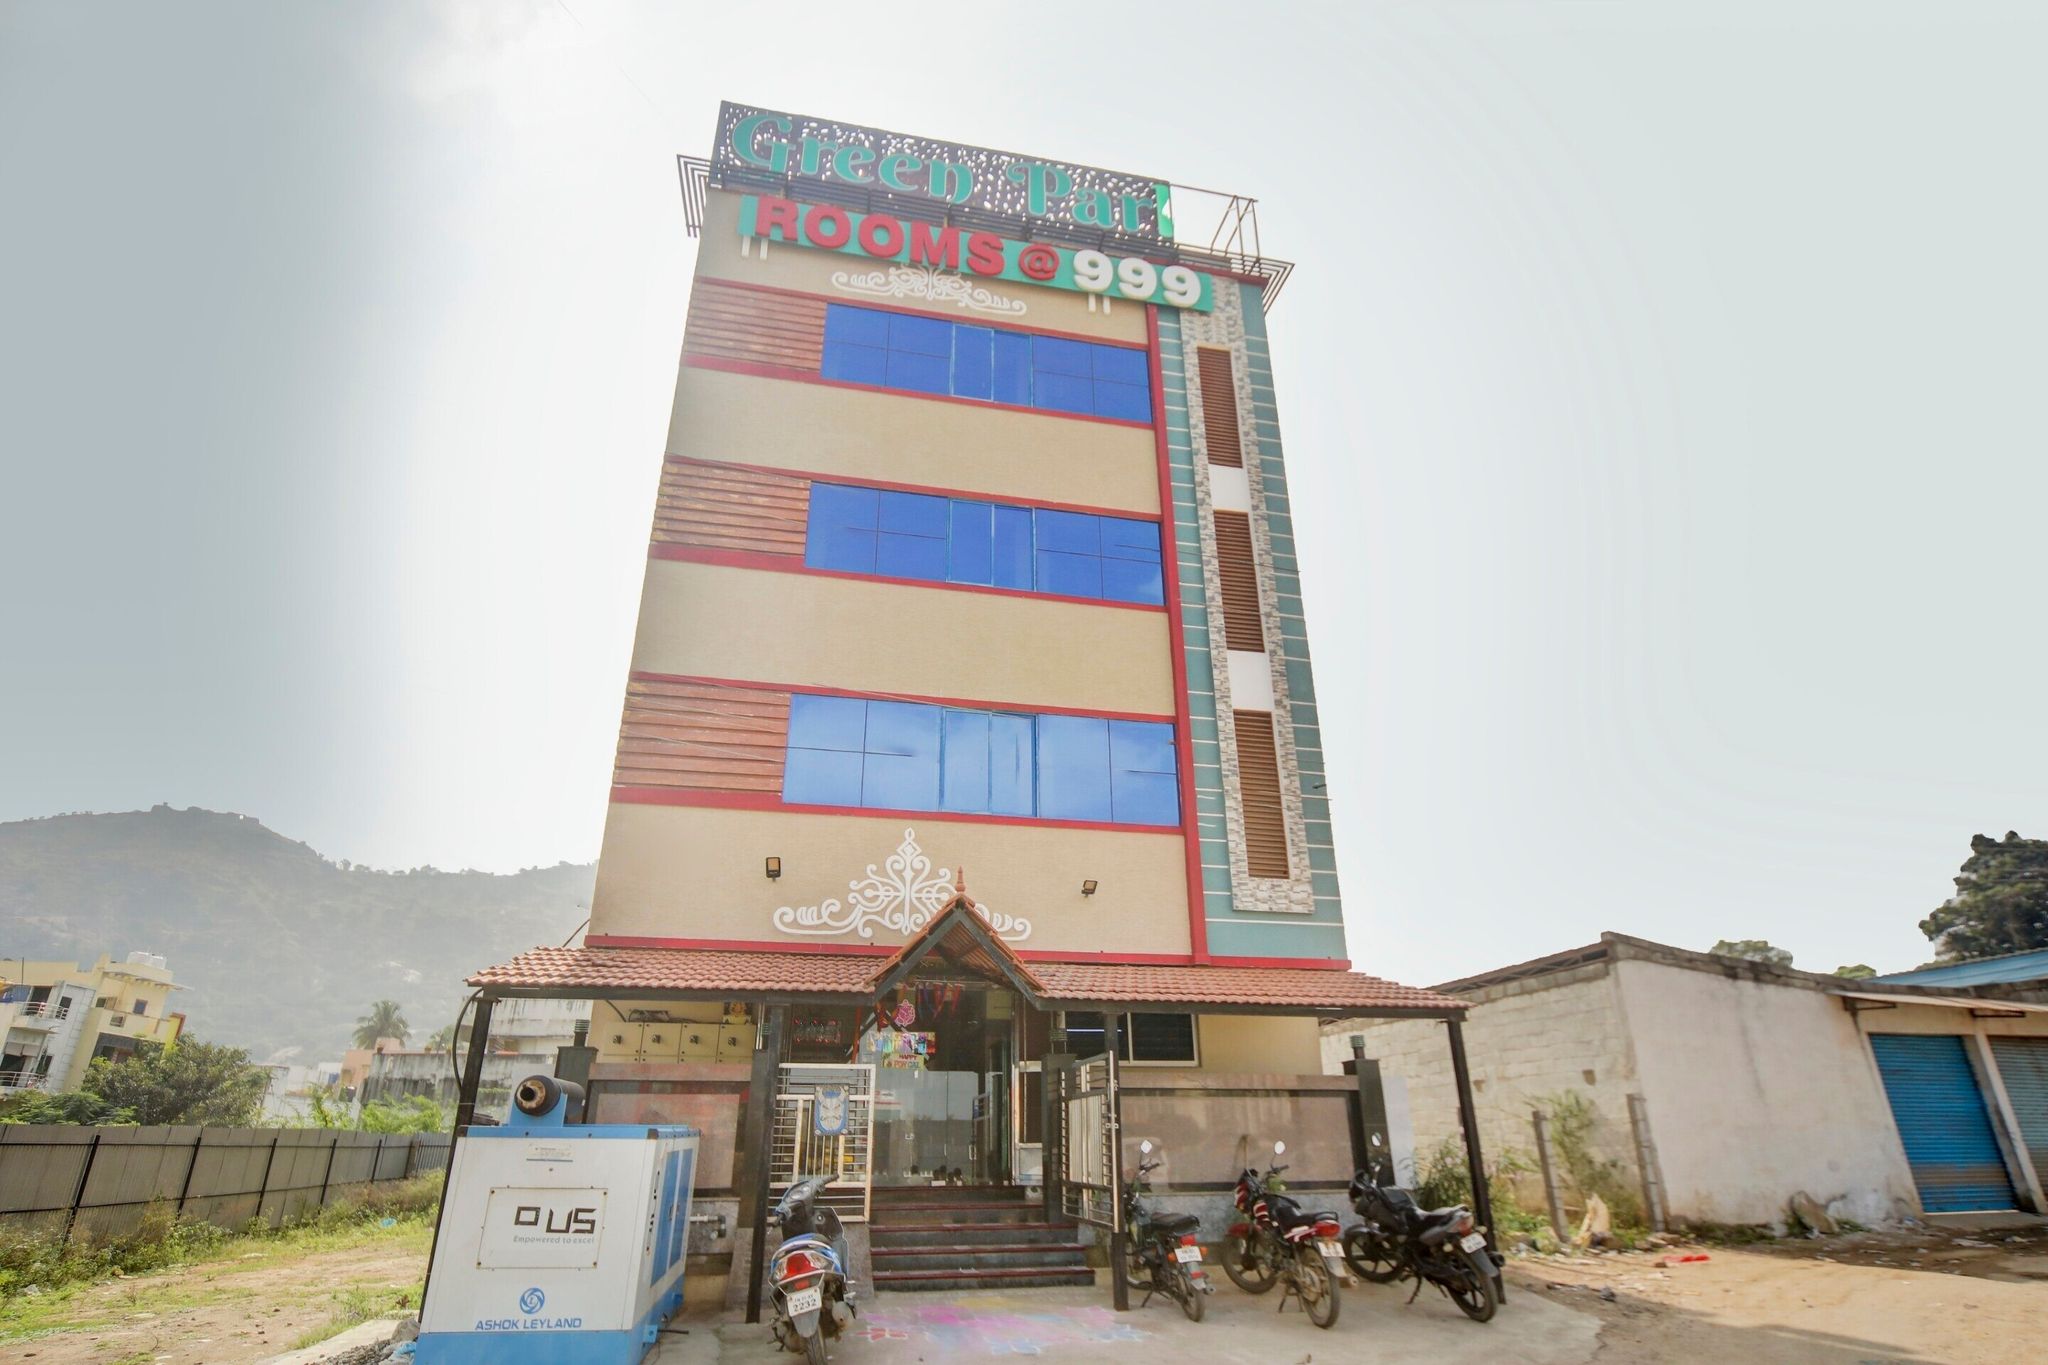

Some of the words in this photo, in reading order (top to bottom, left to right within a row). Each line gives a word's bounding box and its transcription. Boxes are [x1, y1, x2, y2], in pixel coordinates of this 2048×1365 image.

[731, 114, 974, 203] Green
[756, 193, 1006, 276] ROOMS
[1018, 243, 1060, 280] @
[1073, 249, 1202, 308] 999
[513, 1235, 561, 1245] Empowered
[475, 1319, 520, 1331] ASHOK
[523, 1318, 583, 1330] LEYLAND
